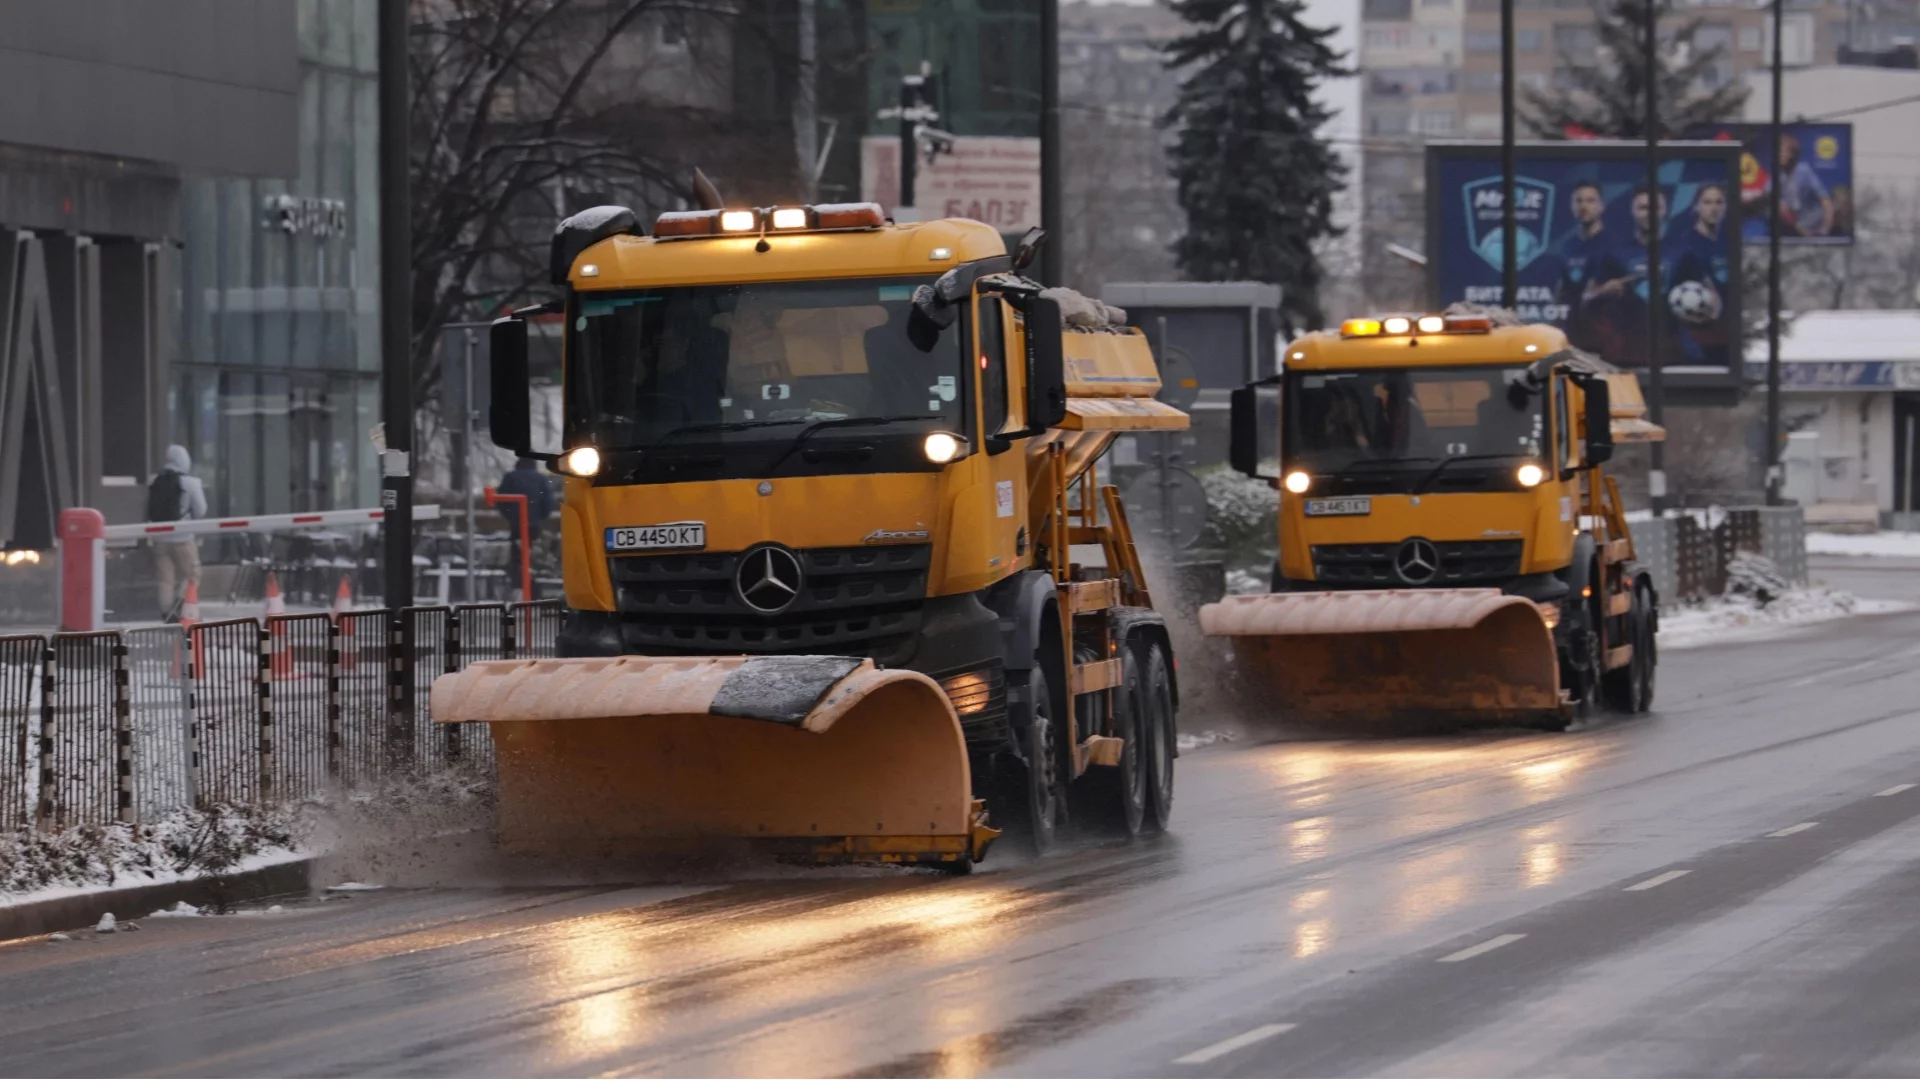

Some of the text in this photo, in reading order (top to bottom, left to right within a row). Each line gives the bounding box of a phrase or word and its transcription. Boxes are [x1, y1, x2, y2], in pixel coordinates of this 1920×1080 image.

[1465, 286, 1552, 302] БИТАТА
[616, 527, 700, 546] CB 4450 KT
